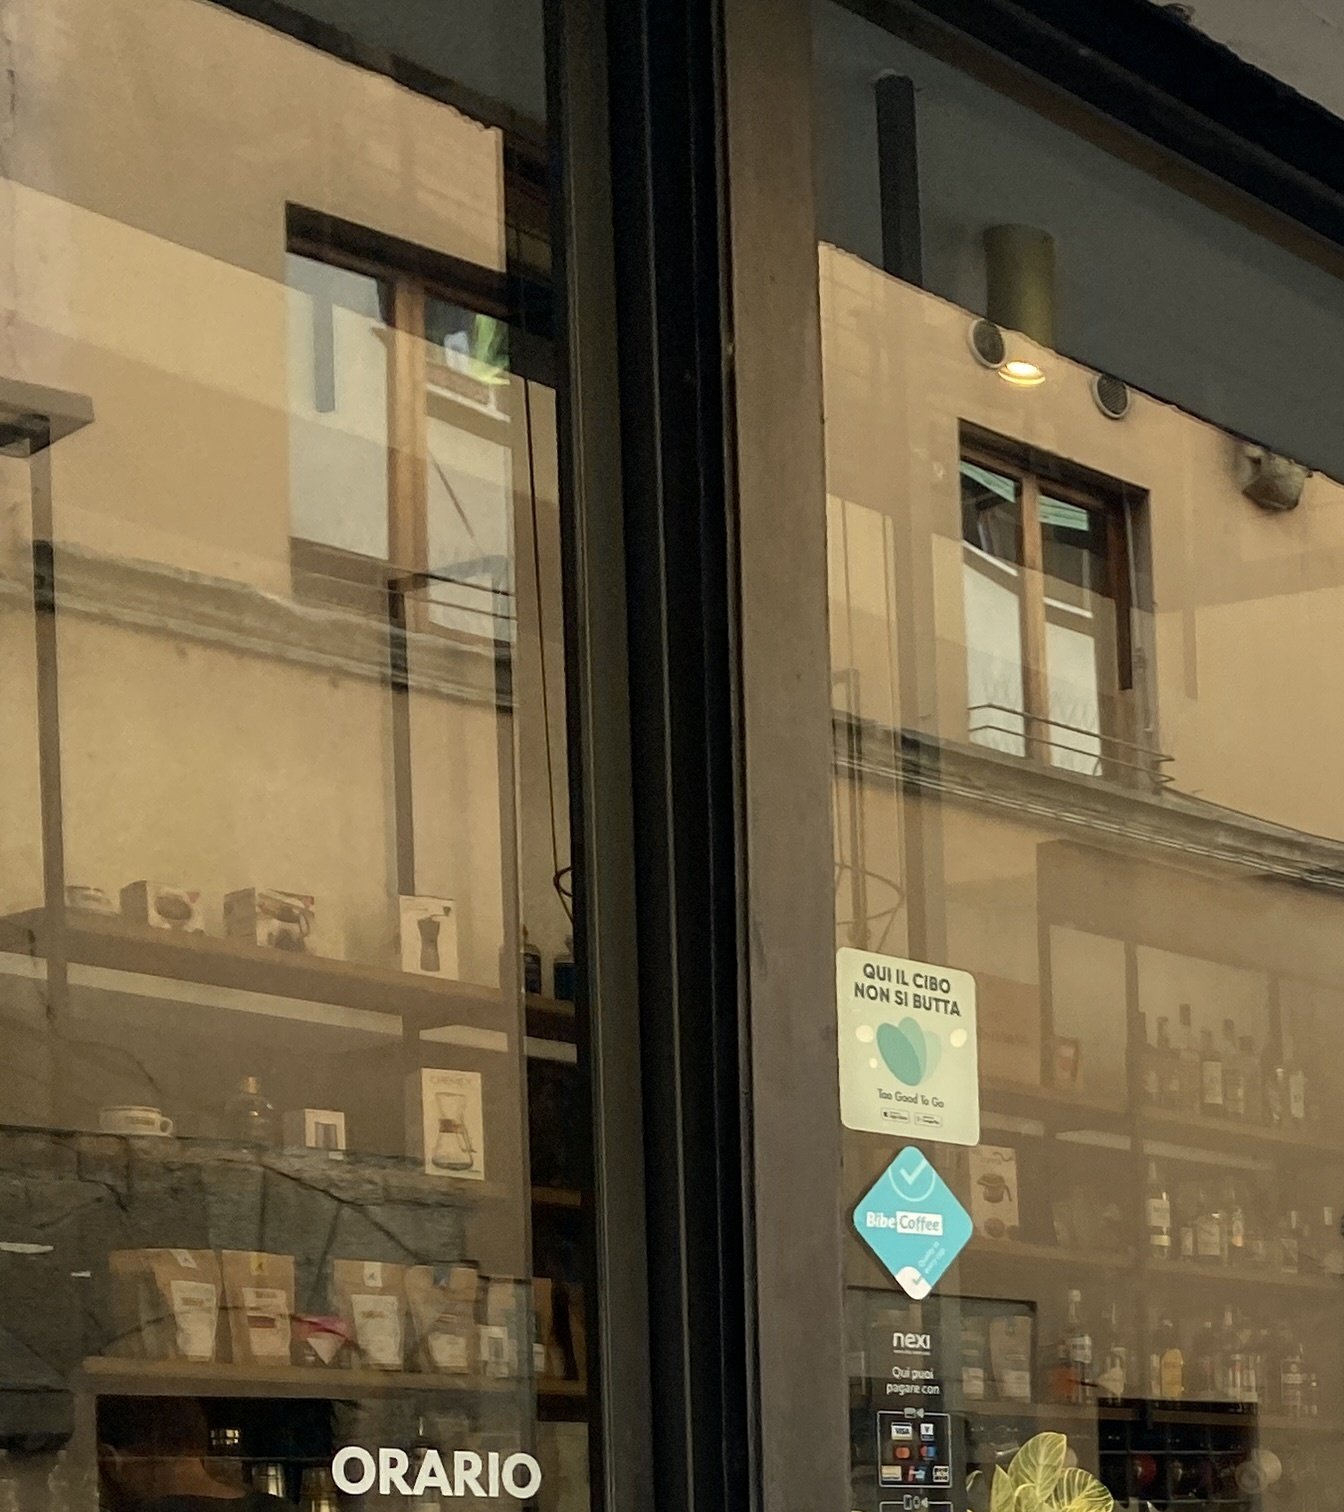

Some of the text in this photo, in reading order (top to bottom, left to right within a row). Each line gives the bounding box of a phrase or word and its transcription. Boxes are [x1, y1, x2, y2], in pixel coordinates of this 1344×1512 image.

[863, 963, 951, 994] QUI IL CIBO
[854, 982, 962, 1017] NON SI BUTTA
[877, 1088, 944, 1108] Too Good To Go
[893, 1332, 931, 1349] nexi
[892, 1366, 934, 1380] Qui puoi
[886, 1383, 940, 1396] pagare con
[332, 1446, 542, 1499] ORARIO
